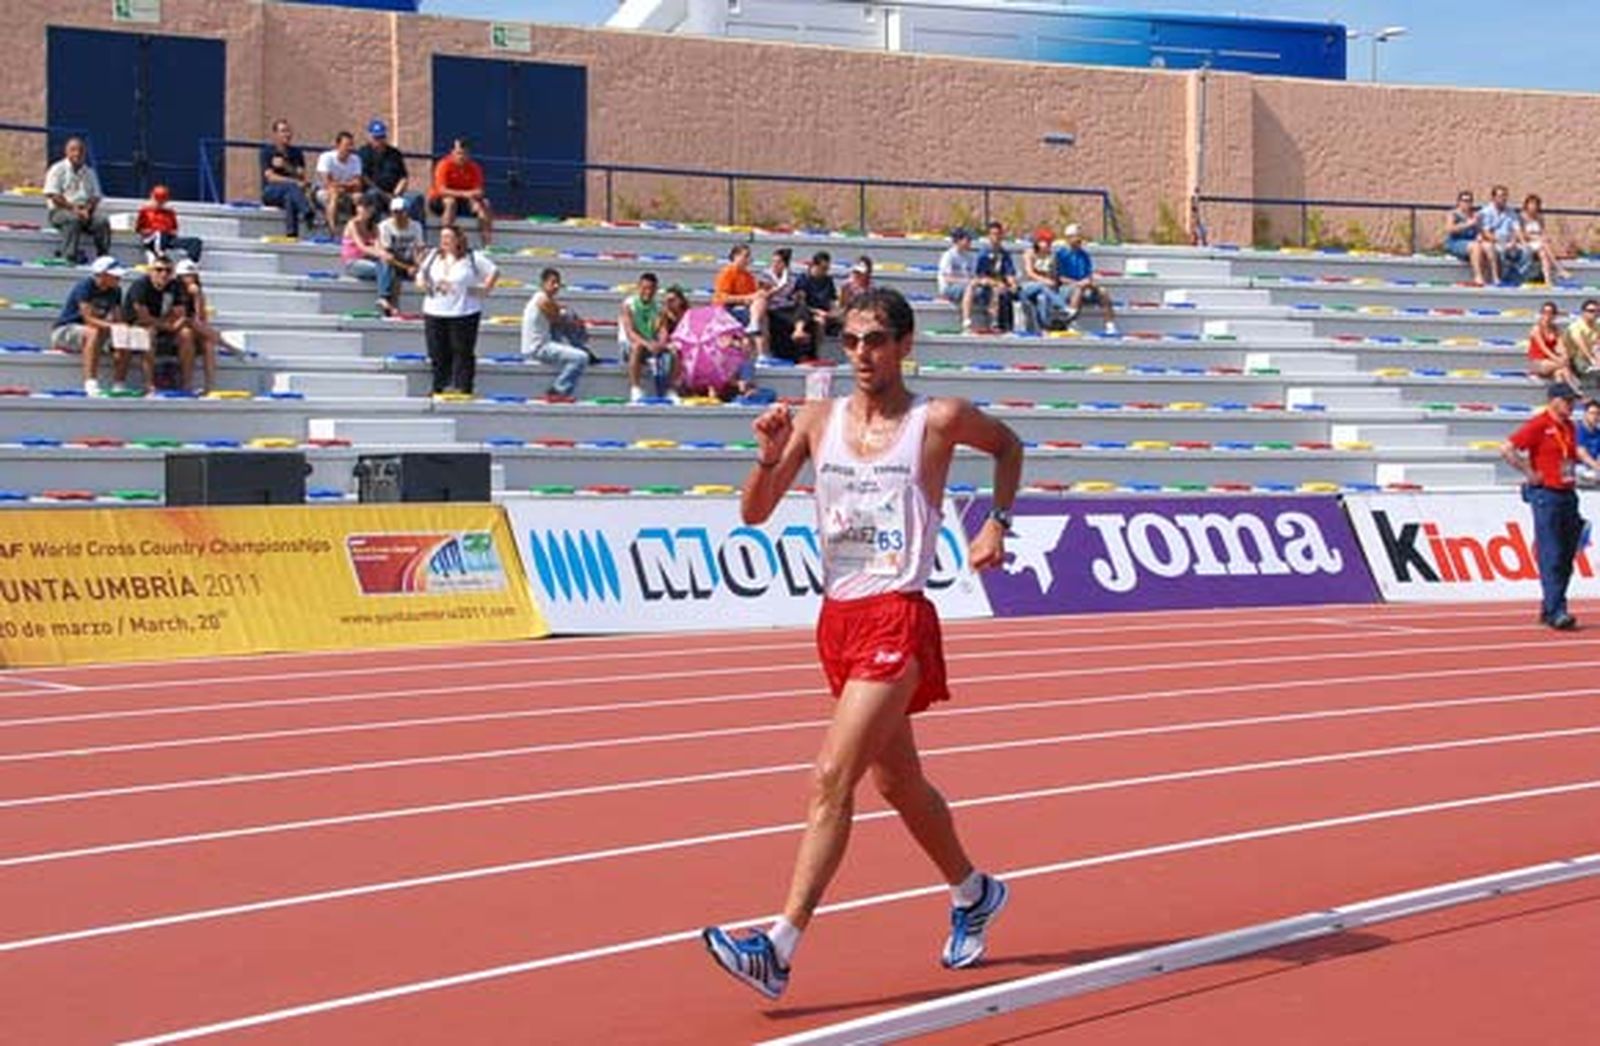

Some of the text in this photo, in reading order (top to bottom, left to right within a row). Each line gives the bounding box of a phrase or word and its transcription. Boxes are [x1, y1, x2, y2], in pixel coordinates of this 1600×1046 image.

[30, 541, 82, 558] World
[87, 539, 136, 557] Cross
[140, 538, 205, 557] Country
[210, 537, 332, 556] Championships
[878, 529, 903, 551] 63
[1371, 510, 1593, 582] kindr
[630, 526, 964, 601] MONO
[204, 572, 261, 597] 2011
[22, 620, 46, 639] de
[51, 621, 113, 637] marzo
